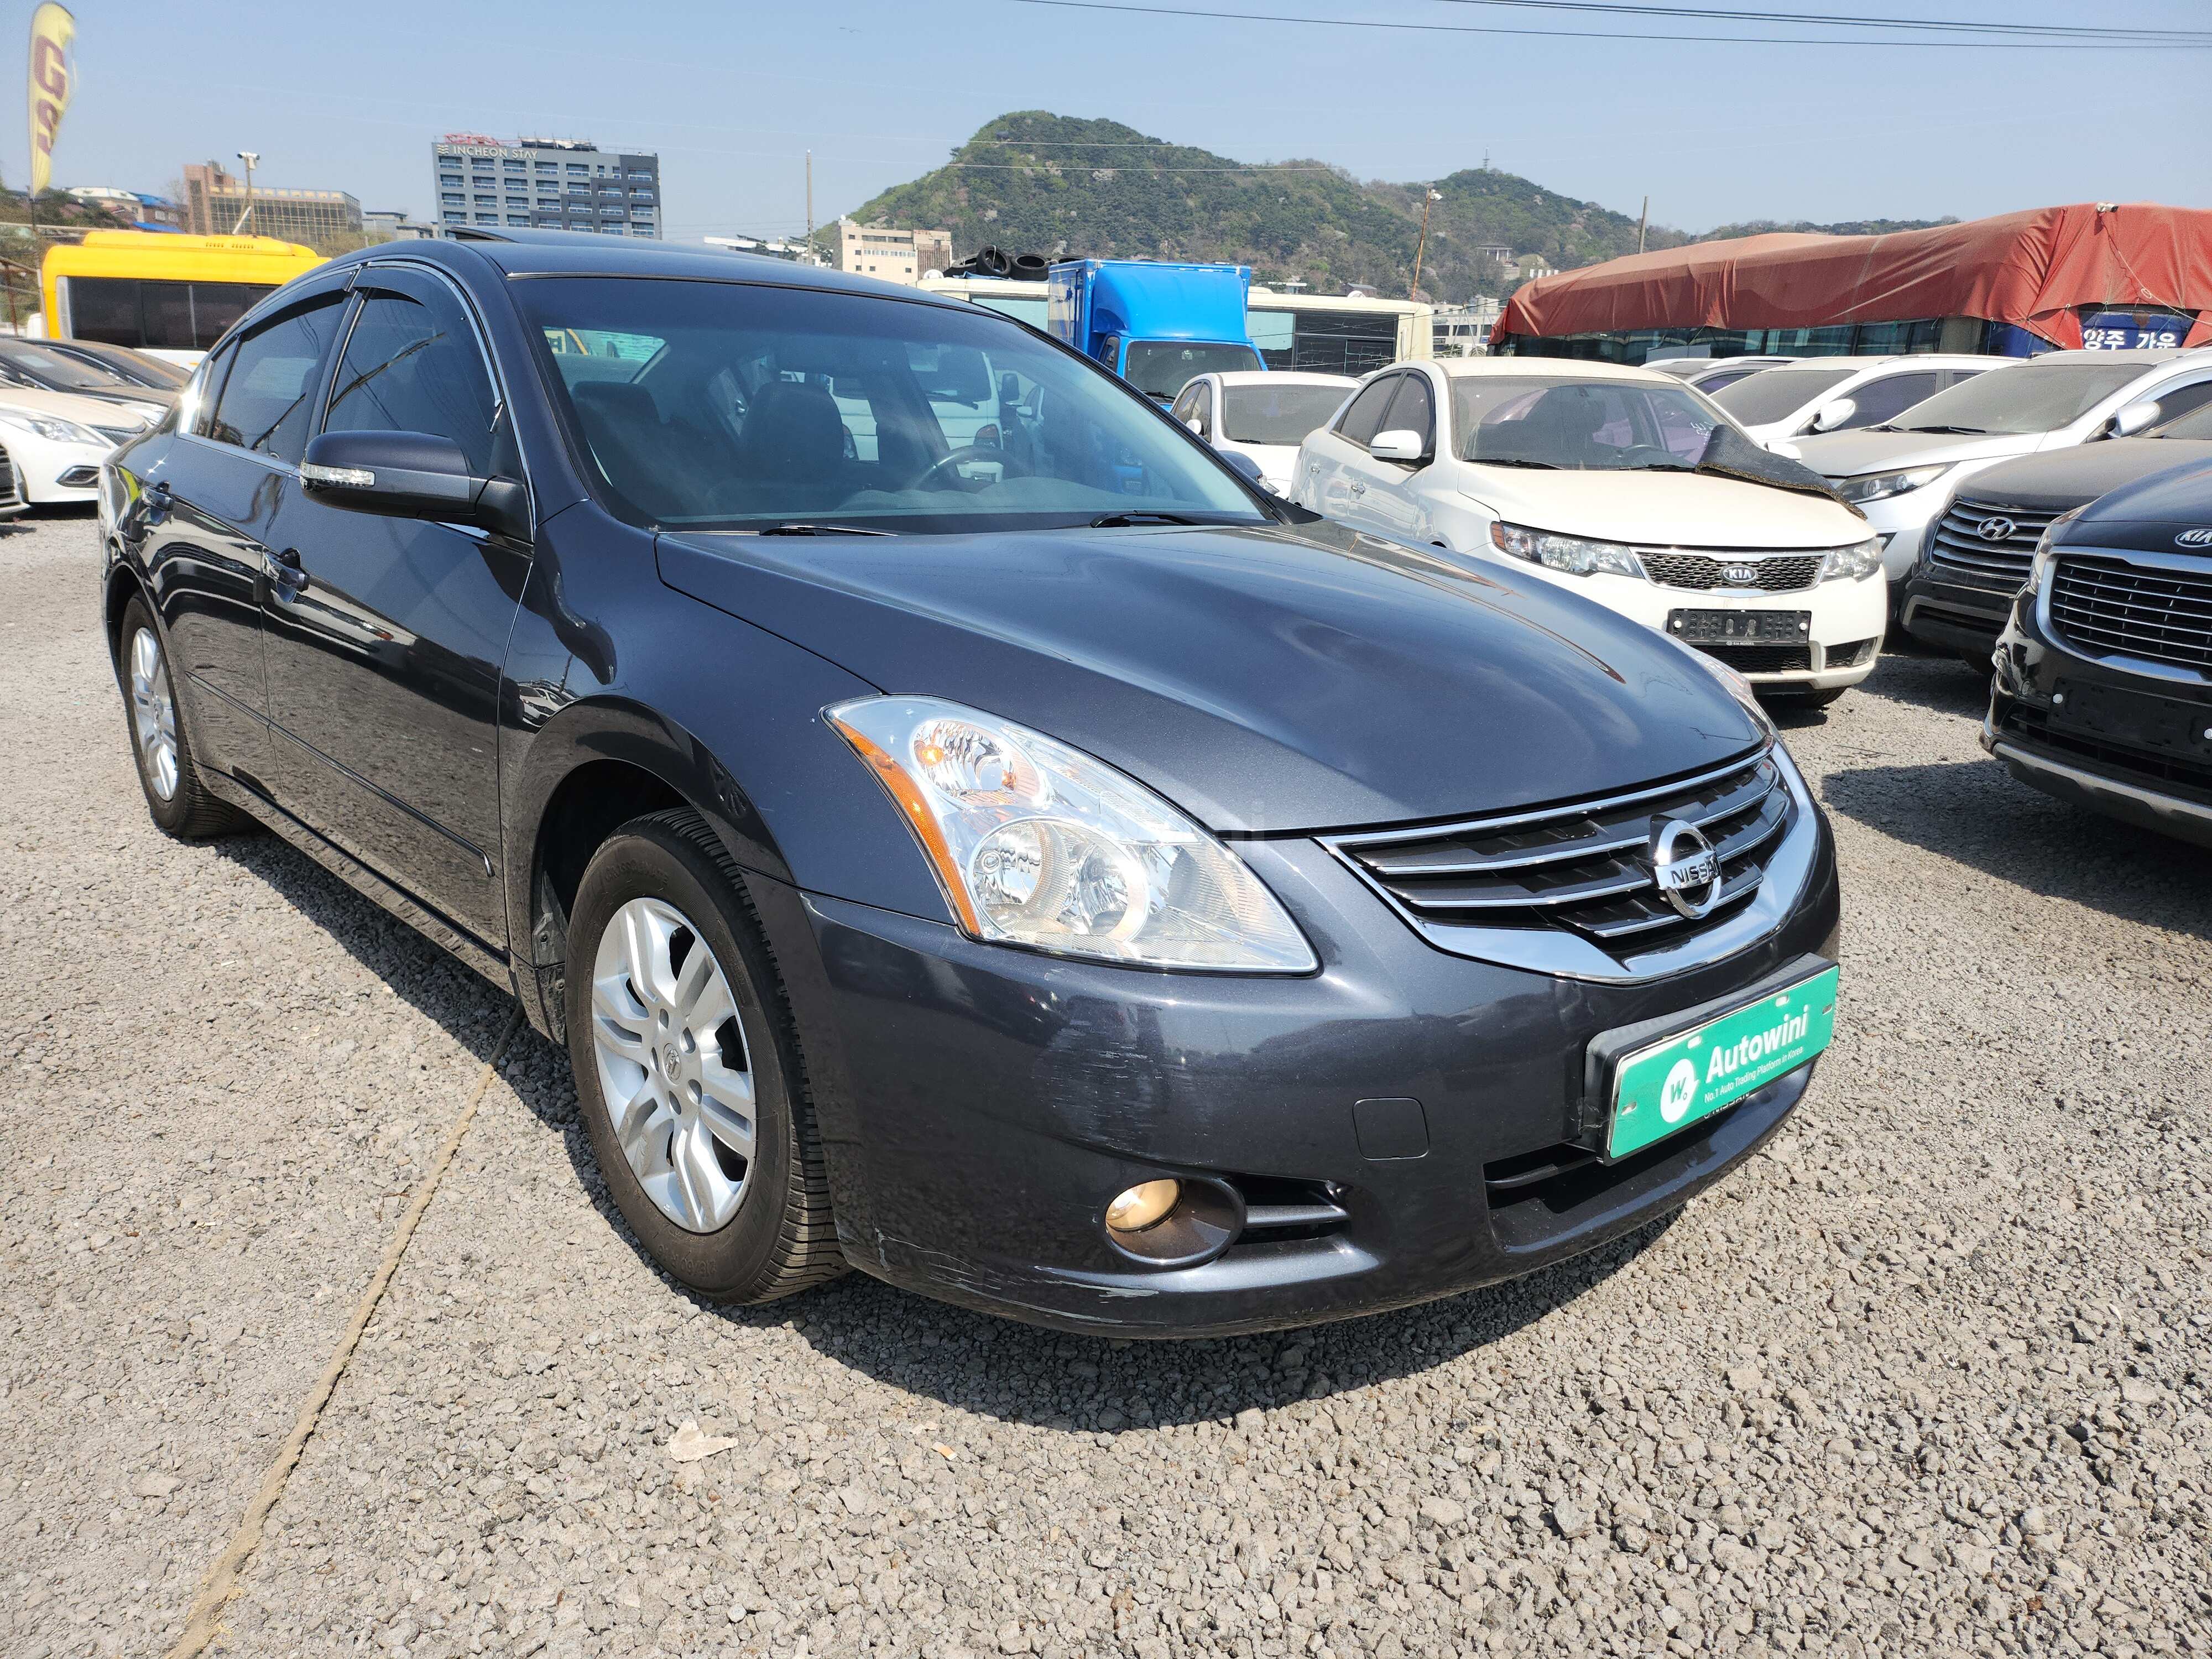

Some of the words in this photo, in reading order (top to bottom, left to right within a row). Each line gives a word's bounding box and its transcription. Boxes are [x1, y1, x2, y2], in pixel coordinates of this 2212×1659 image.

[453, 145, 508, 158] INCHEON
[512, 149, 538, 160] STAY
[1728, 568, 1752, 579] KIA
[1705, 1004, 1809, 1084] Autowini
[1704, 1087, 1719, 1104] No.1
[1719, 1082, 1734, 1095] Auto
[1734, 1070, 1756, 1088] Trading
[1757, 1057, 1781, 1076] Platform
[1781, 1054, 1788, 1064] in
[1788, 1046, 1803, 1060] Korea
